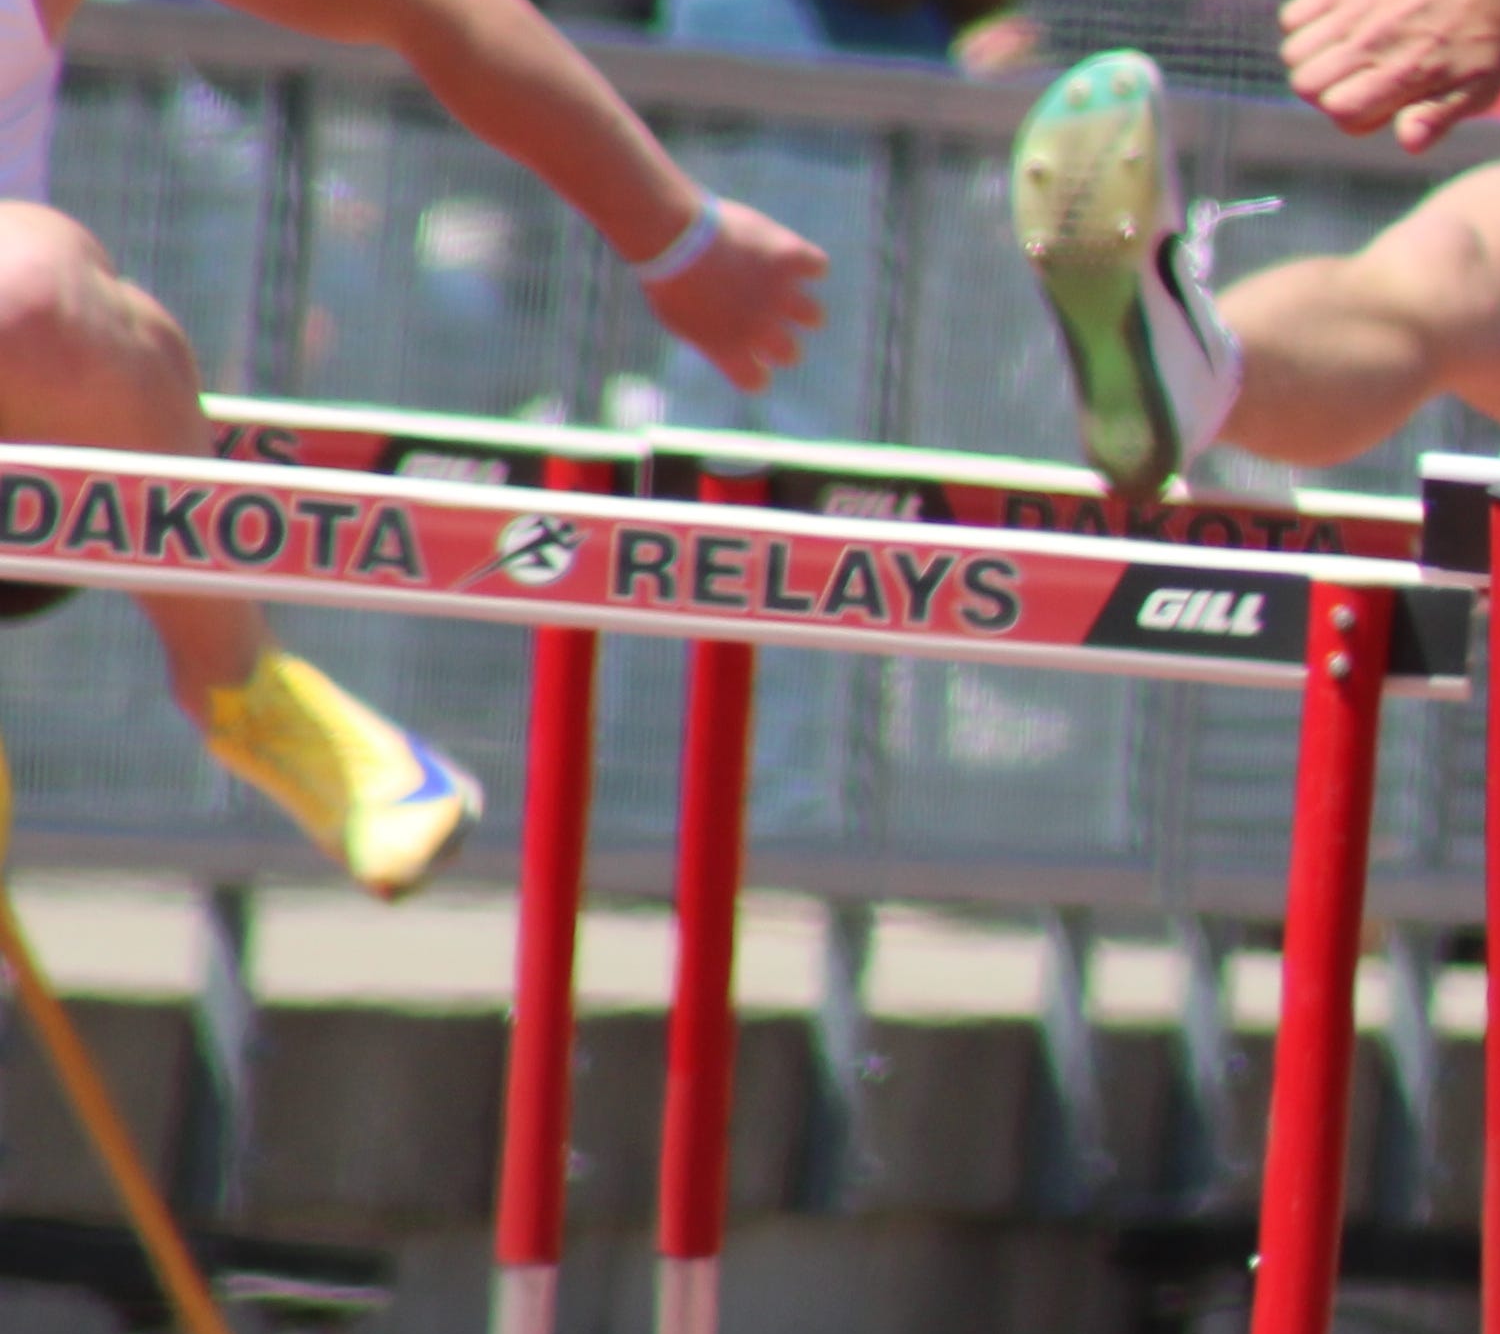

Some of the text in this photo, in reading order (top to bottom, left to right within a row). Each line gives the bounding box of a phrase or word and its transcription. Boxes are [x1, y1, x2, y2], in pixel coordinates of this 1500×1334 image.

[0, 472, 1266, 636] DAKOTA RELAYS GILL
